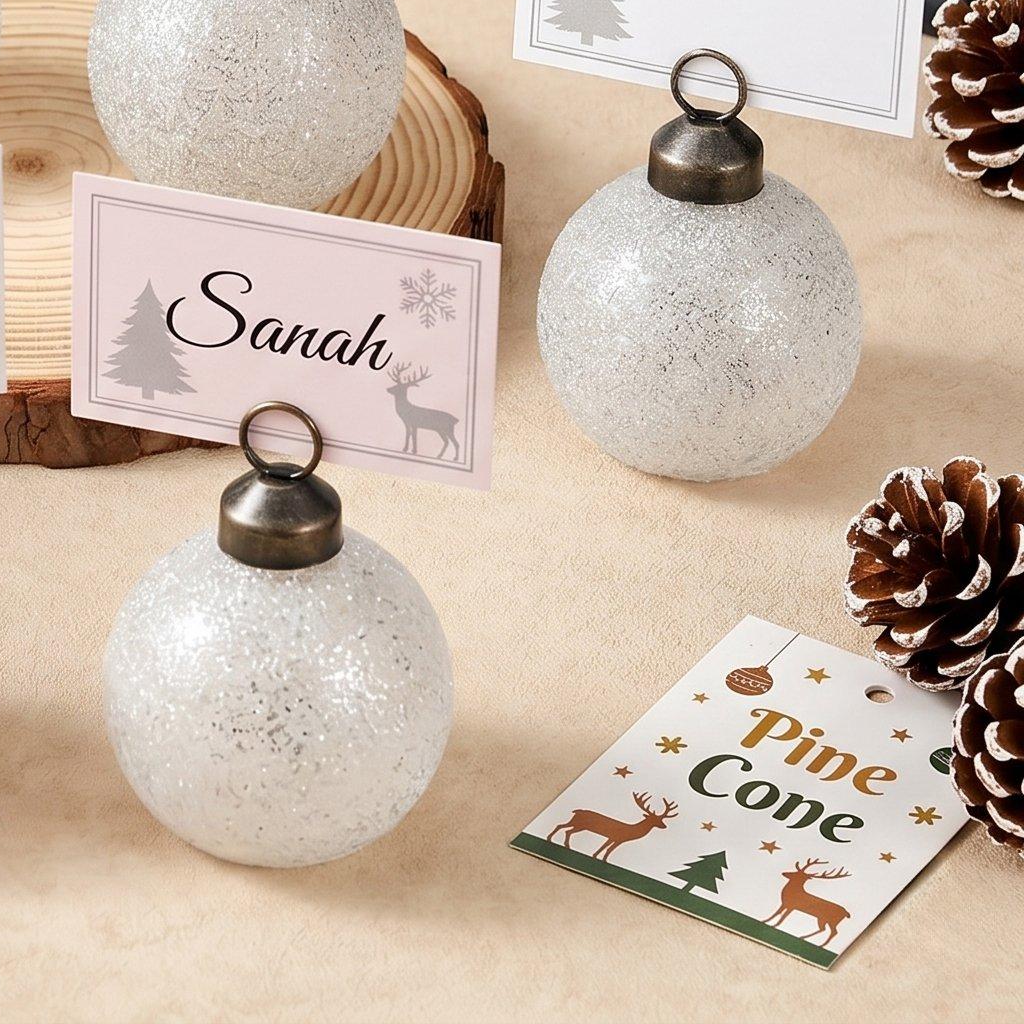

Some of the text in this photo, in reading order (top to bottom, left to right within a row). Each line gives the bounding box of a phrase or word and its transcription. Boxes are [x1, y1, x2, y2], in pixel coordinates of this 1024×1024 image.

[166, 270, 393, 371] Sanah
[738, 707, 898, 796] Pine
[688, 753, 865, 843] Cone
